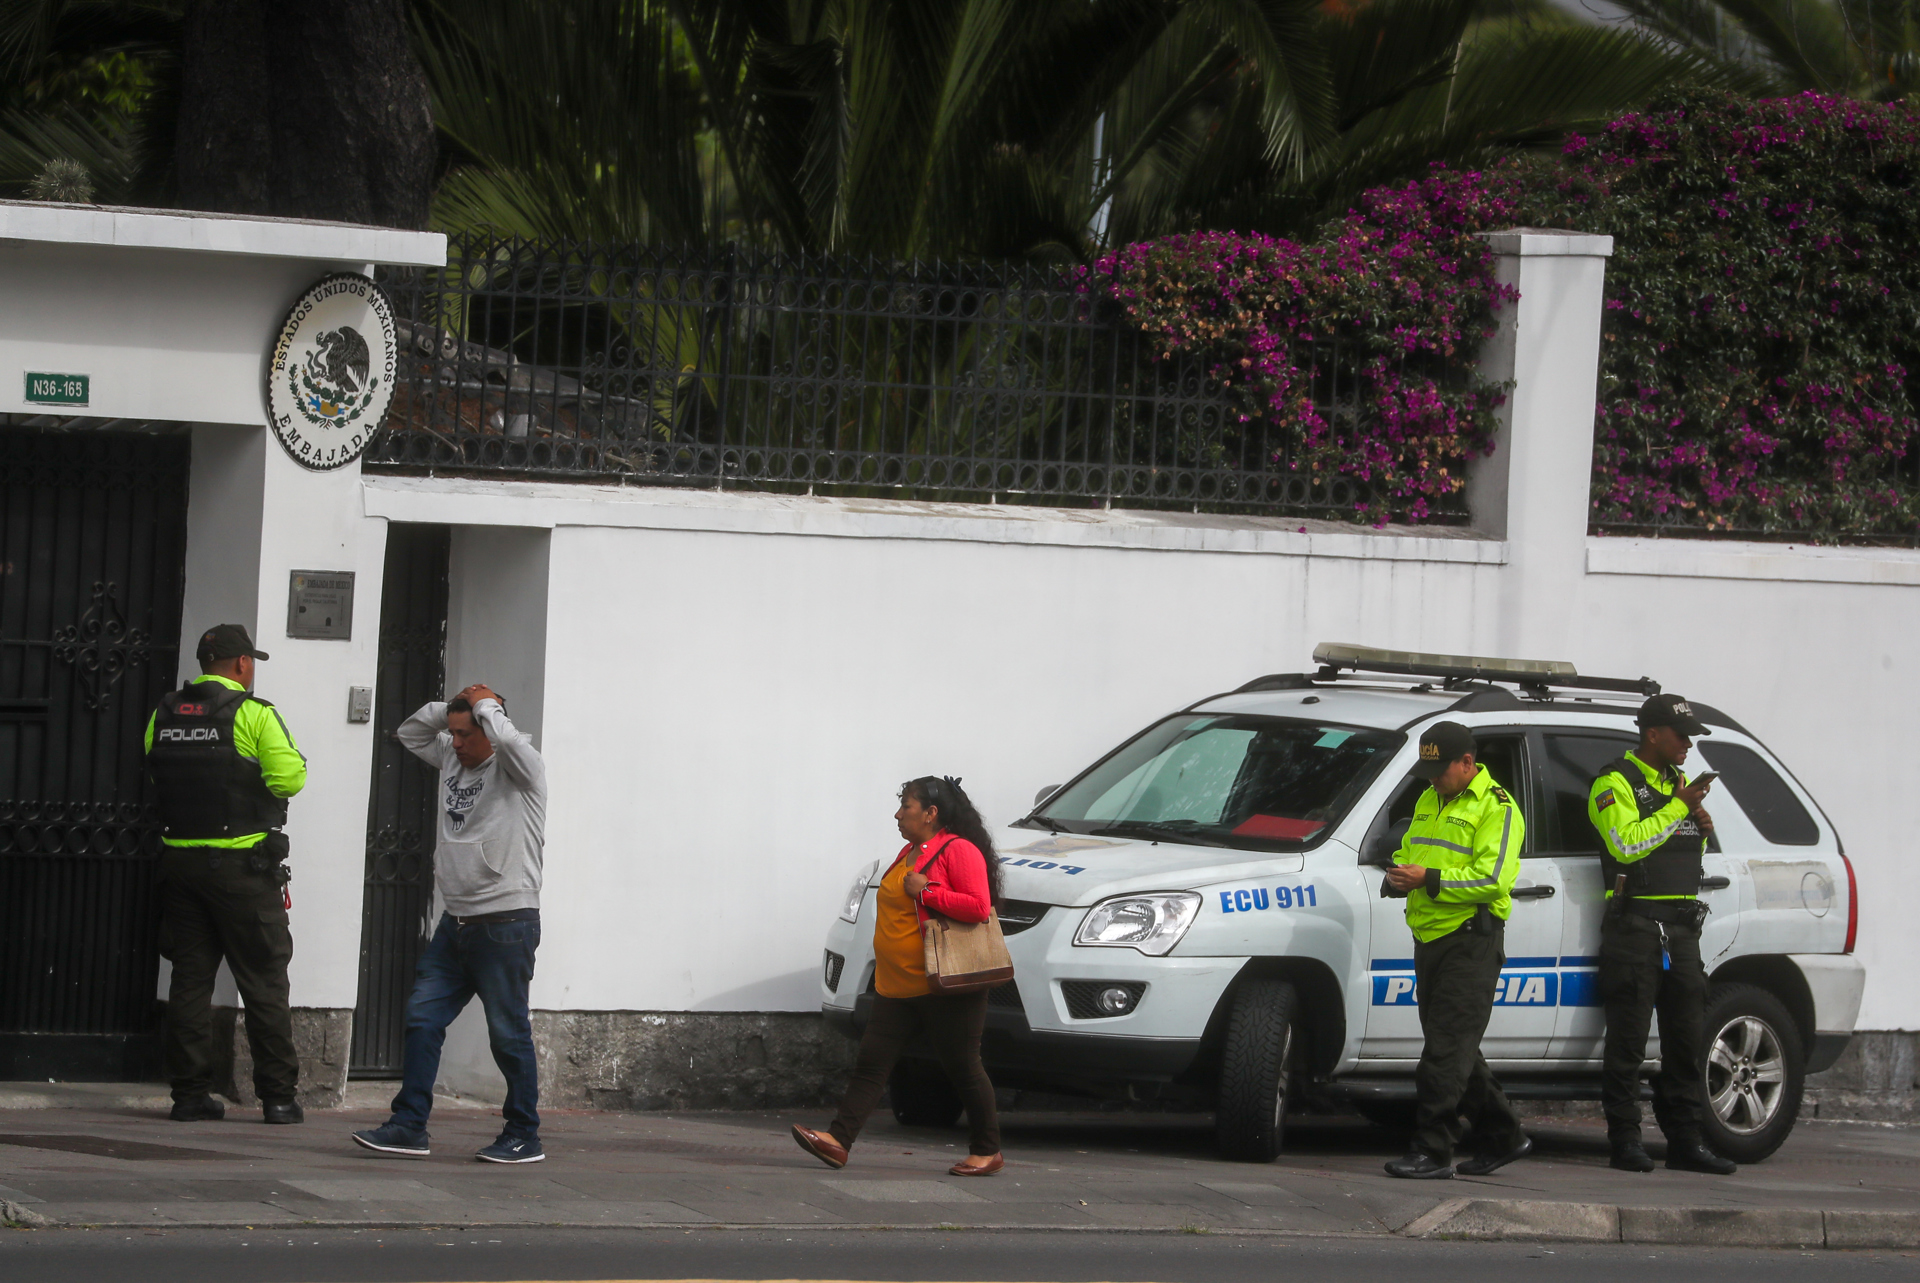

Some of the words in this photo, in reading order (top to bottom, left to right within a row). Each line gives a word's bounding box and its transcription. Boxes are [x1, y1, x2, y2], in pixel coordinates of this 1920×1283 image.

[276, 302, 313, 371] ESTADOS
[313, 282, 366, 303] UNIDOS
[366, 293, 393, 382] MEXICANOS
[279, 413, 374, 461] EMBAJADA
[159, 728, 219, 741] POLICIA
[1219, 887, 1269, 913] ECU
[1276, 884, 1317, 909] 911
